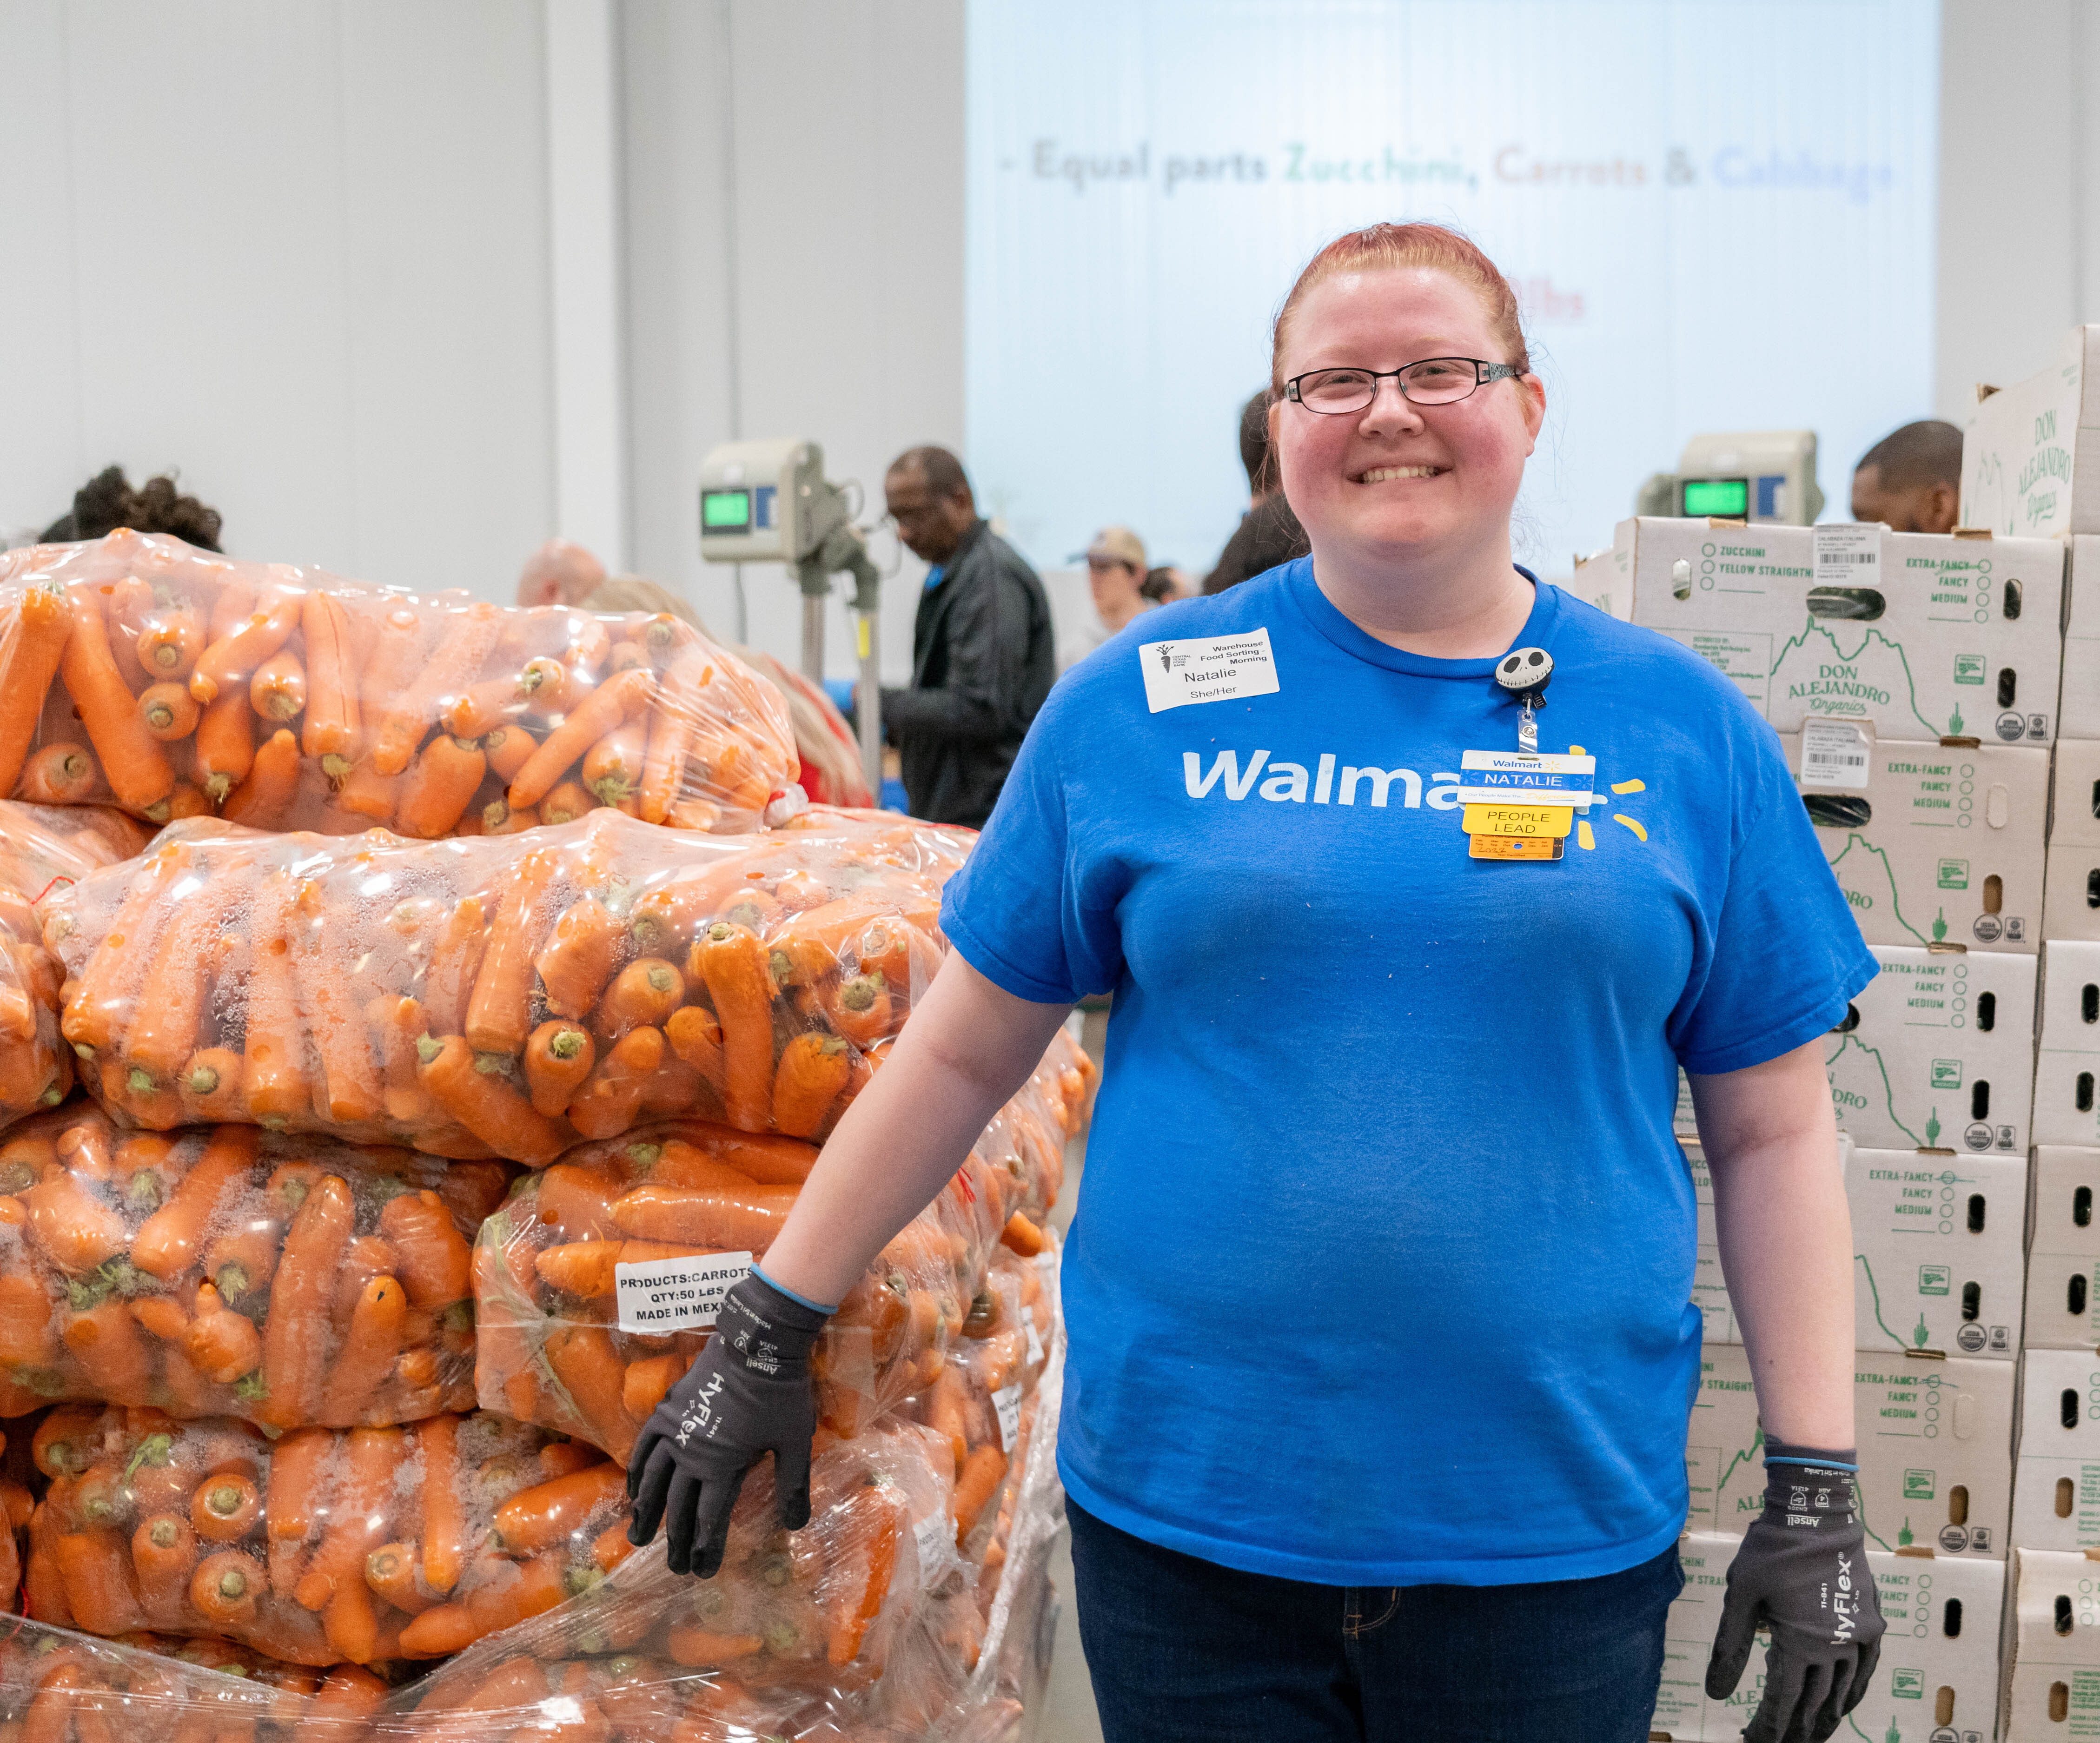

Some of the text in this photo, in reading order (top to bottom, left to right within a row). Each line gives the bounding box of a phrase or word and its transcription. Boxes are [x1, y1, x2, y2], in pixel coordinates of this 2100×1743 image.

[1032, 139, 1149, 196] Equal
[1164, 151, 1266, 197] parts
[1284, 141, 1479, 195] Zucchini,
[1493, 145, 1647, 187] Carrots
[1663, 145, 1697, 187] &
[2035, 409, 2057, 446] DON
[2018, 446, 2071, 497] ALEJANDRO
[1720, 546, 1766, 557] ZUCCHINI
[1907, 557, 1970, 570] EXTRA-FANCY
[1720, 563, 1814, 578] YELLOW STRAIGHTN
[1939, 577, 1969, 587] FANCY
[1931, 593, 1968, 604] MEDIUM
[1212, 641, 1264, 652] Warehouse
[1200, 653, 1224, 662] Food
[1226, 649, 1259, 658] Sorting
[1230, 655, 1267, 665] Morning
[1185, 668, 1237, 683] Natalie
[1819, 664, 1858, 680] DON
[1190, 686, 1237, 699] She/Her
[1789, 681, 1890, 706] ALEJANDRO
[1809, 697, 1867, 716] Organics
[1493, 759, 1543, 769] Walmart
[1888, 762, 1952, 776] EXTRA-FANCY
[1182, 749, 1609, 815] Walma
[1484, 774, 1563, 787] NATALIE
[1921, 782, 1951, 792] FANCY
[1913, 797, 1951, 809] MEDIUM
[1487, 811, 1551, 822] PEOPLE
[1494, 823, 1536, 834] LEAD
[1882, 963, 1946, 975] EXTRA-FANCY
[1915, 981, 1945, 993] FANCY
[1907, 997, 1944, 1009] MEDIUM
[1869, 1169, 1934, 1183] EXTRA-FANCY
[1902, 1188, 1933, 1199] FANCY
[1895, 1204, 1933, 1215] MEDIUM
[651, 1286, 724, 1303] QTY:50 LBS
[636, 1302, 721, 1320] MADE IN MEX
[746, 1357, 778, 1375] Ansell
[1708, 1379, 1753, 1392] STRAIGHT
[1855, 1372, 1919, 1386] EXTRA-FANCY
[1888, 1391, 1918, 1403] FANCY
[675, 1372, 725, 1449] HyFlex
[1880, 1407, 1917, 1419] MEDIUM
[706, 1416, 722, 1438] 11-841
[1803, 1467, 1824, 1476] Lanka
[1787, 1516, 1820, 1527] Ansell
[1679, 1556, 1705, 1567] CHINI
[1873, 1573, 1910, 1586] -FANCY
[1830, 1558, 1853, 1645] HyFlex
